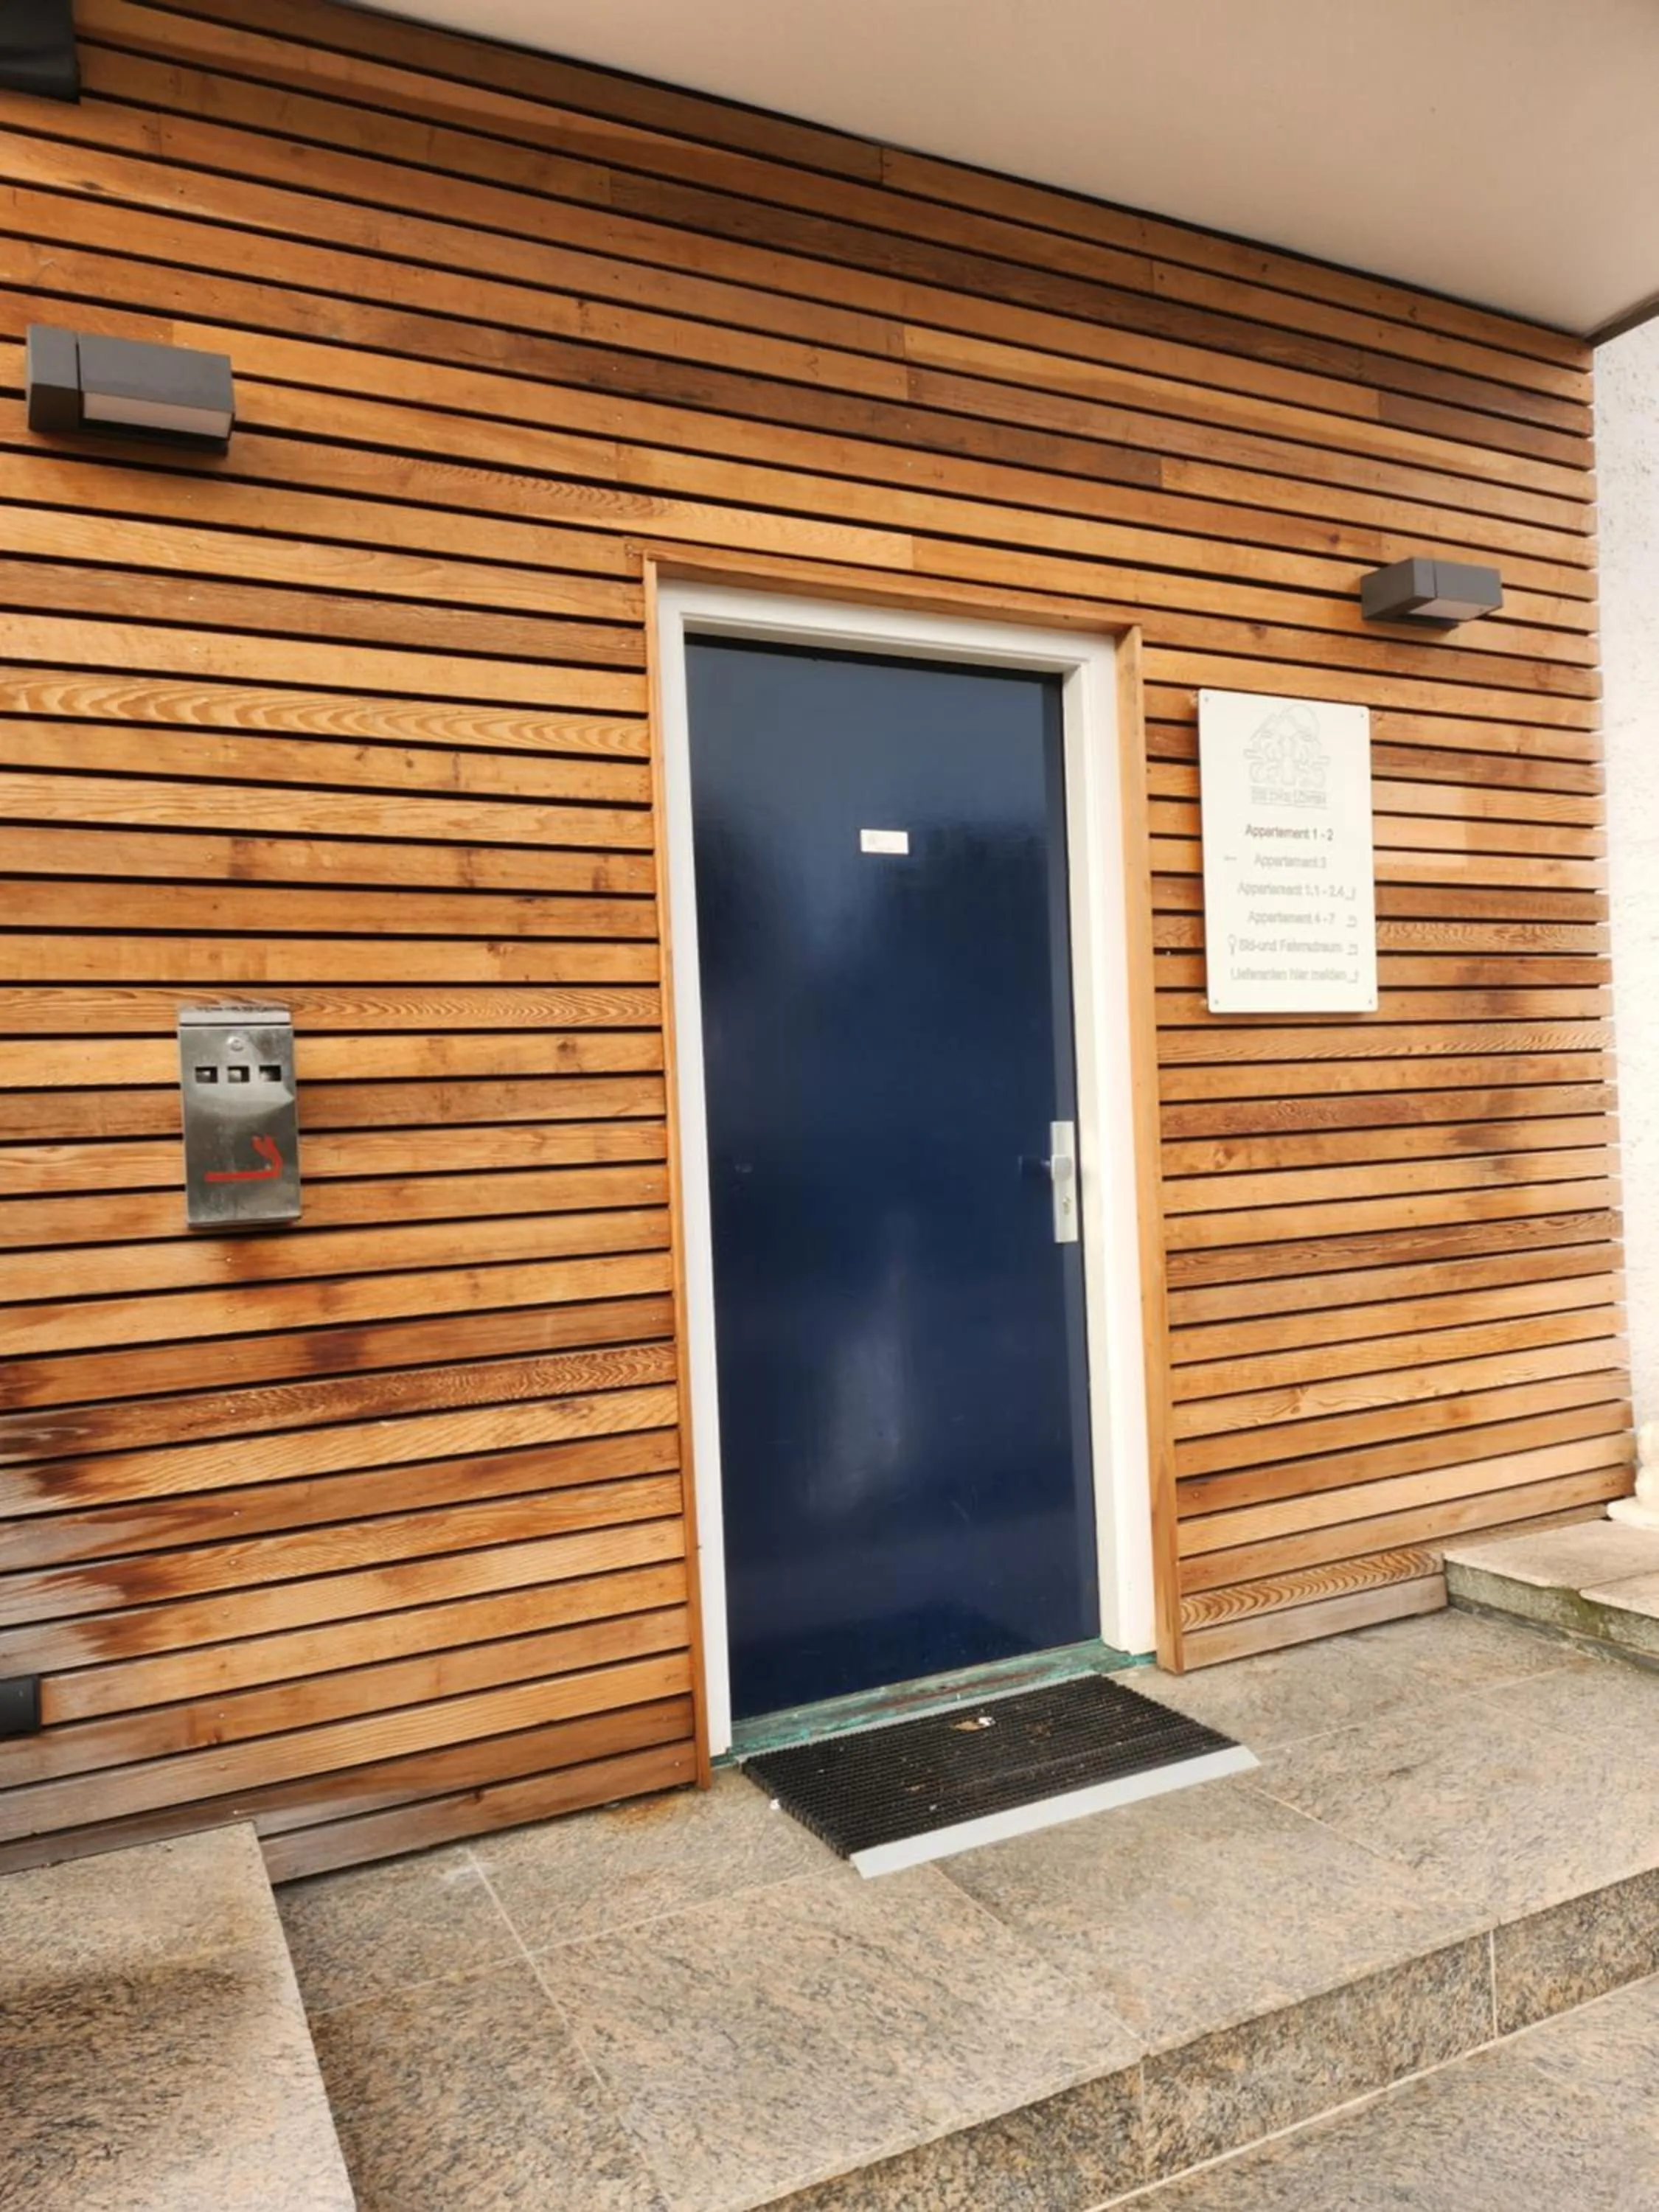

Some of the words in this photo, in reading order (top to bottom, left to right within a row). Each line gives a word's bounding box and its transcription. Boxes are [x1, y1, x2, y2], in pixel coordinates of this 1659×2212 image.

[1245, 824, 1310, 840] Appartement
[1312, 828, 1318, 840] 1
[1326, 828, 1334, 841] 2
